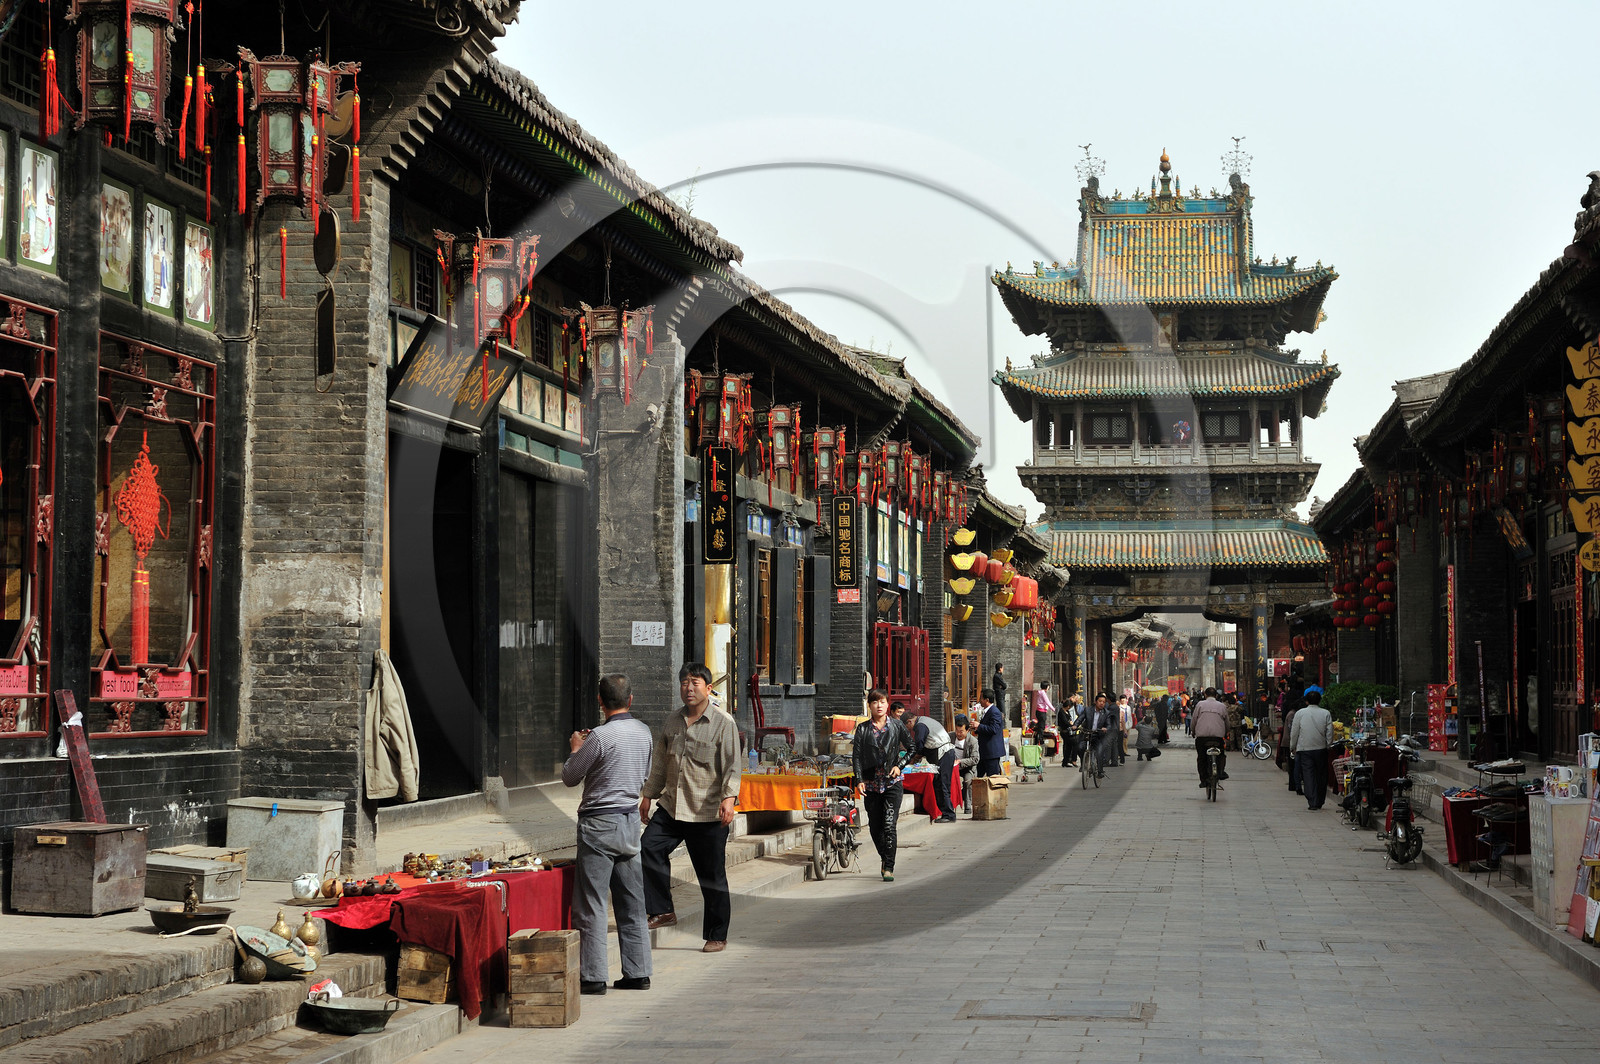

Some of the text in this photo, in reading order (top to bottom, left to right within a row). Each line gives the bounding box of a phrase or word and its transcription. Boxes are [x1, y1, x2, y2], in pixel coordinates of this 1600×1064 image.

[838, 501, 852, 582] 中国驰名商标
[119, 676, 135, 692] food
